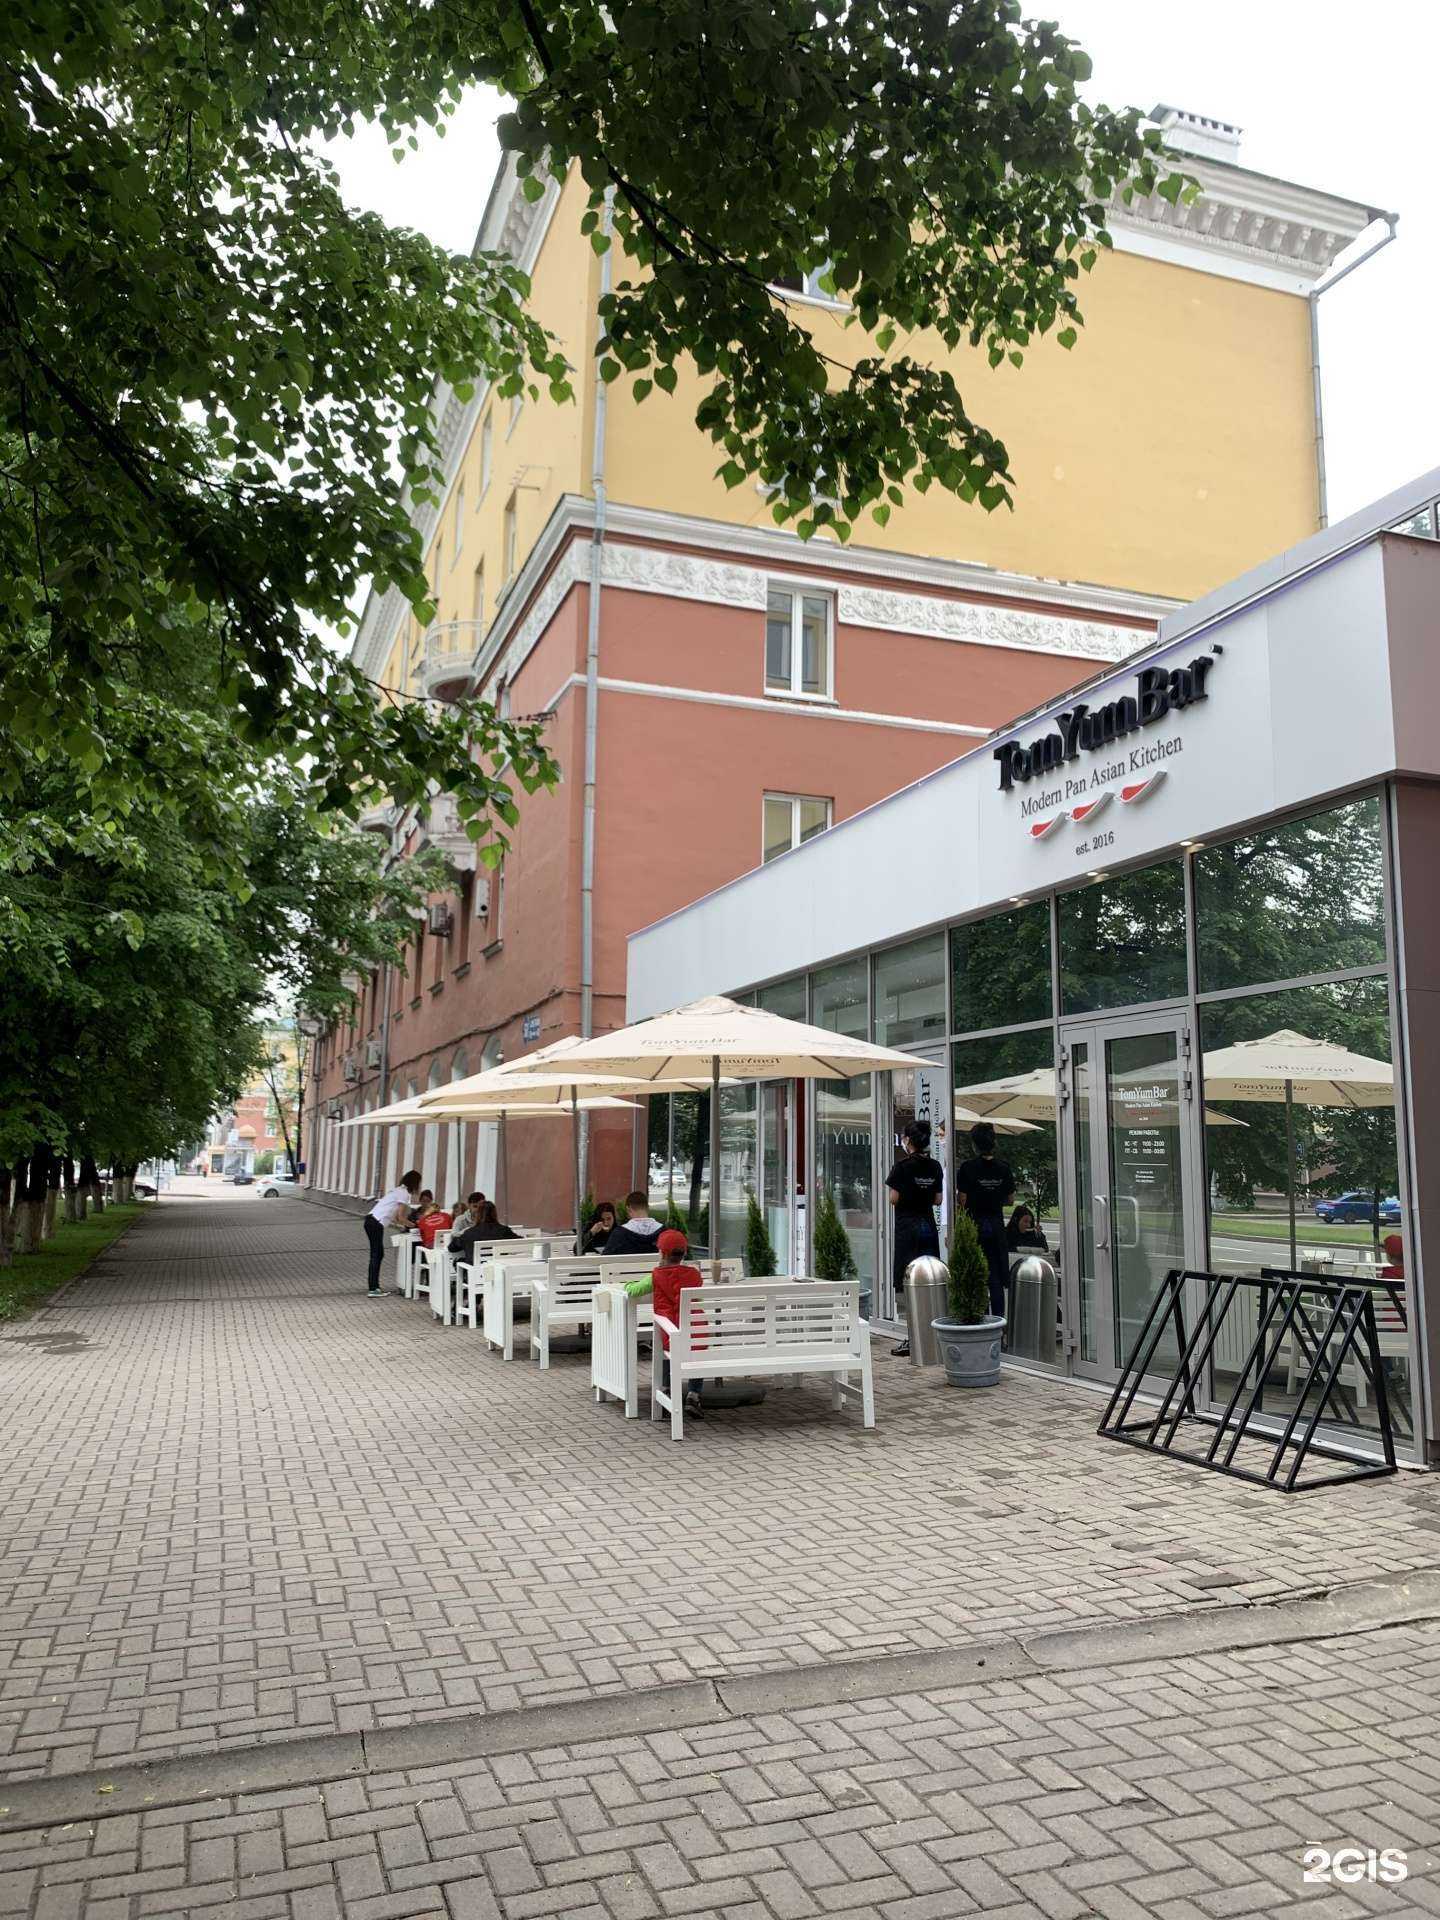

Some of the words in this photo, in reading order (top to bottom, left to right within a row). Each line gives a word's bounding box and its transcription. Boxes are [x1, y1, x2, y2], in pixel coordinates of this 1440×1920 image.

[993, 652, 1216, 792] TomYumBar
[1020, 788, 1063, 819] Modern
[1064, 777, 1087, 800] Pan
[1089, 759, 1126, 788] Asian
[1128, 734, 1183, 772] Kitchen
[1075, 842, 1091, 856] est.
[1092, 830, 1115, 851] 2016
[1118, 1085, 1169, 1101] TomYumBar
